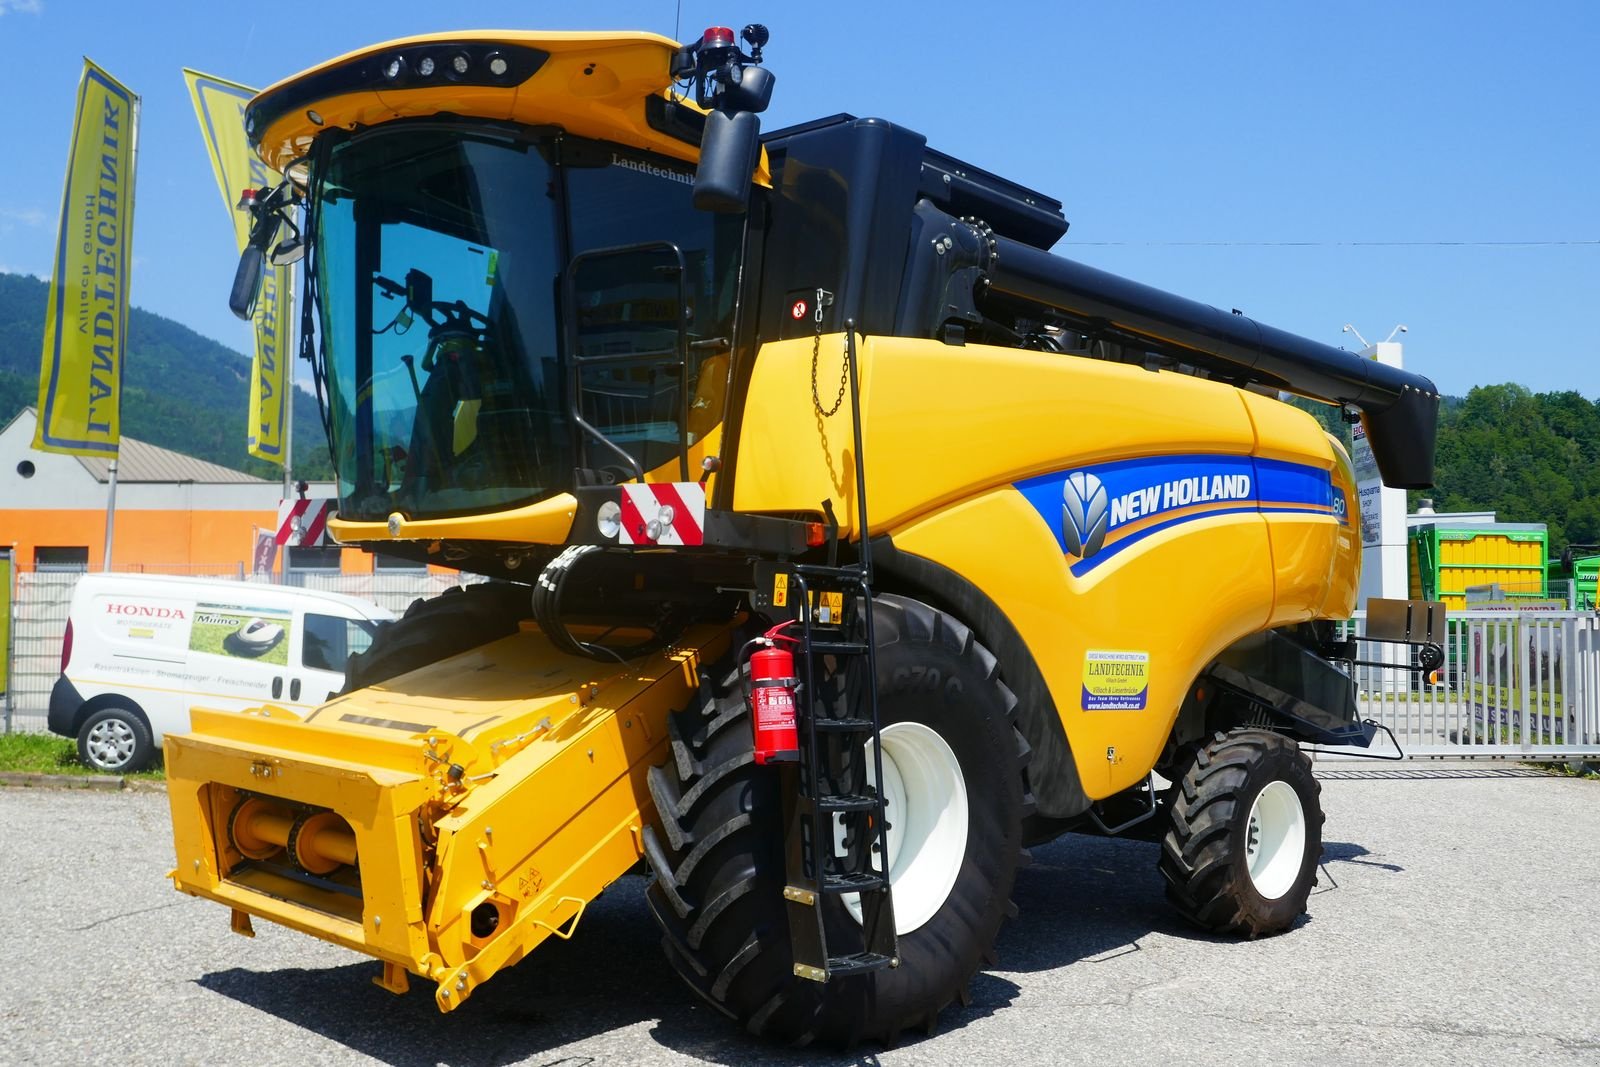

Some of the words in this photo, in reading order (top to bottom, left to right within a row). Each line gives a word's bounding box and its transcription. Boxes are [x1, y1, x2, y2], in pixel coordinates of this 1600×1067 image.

[612, 152, 697, 186] Landtechnik
[1110, 484, 1162, 527] NEW
[1163, 474, 1250, 509] HOLLAND
[106, 603, 185, 620] HONDA
[1088, 662, 1145, 677] LANDTECHNIK
